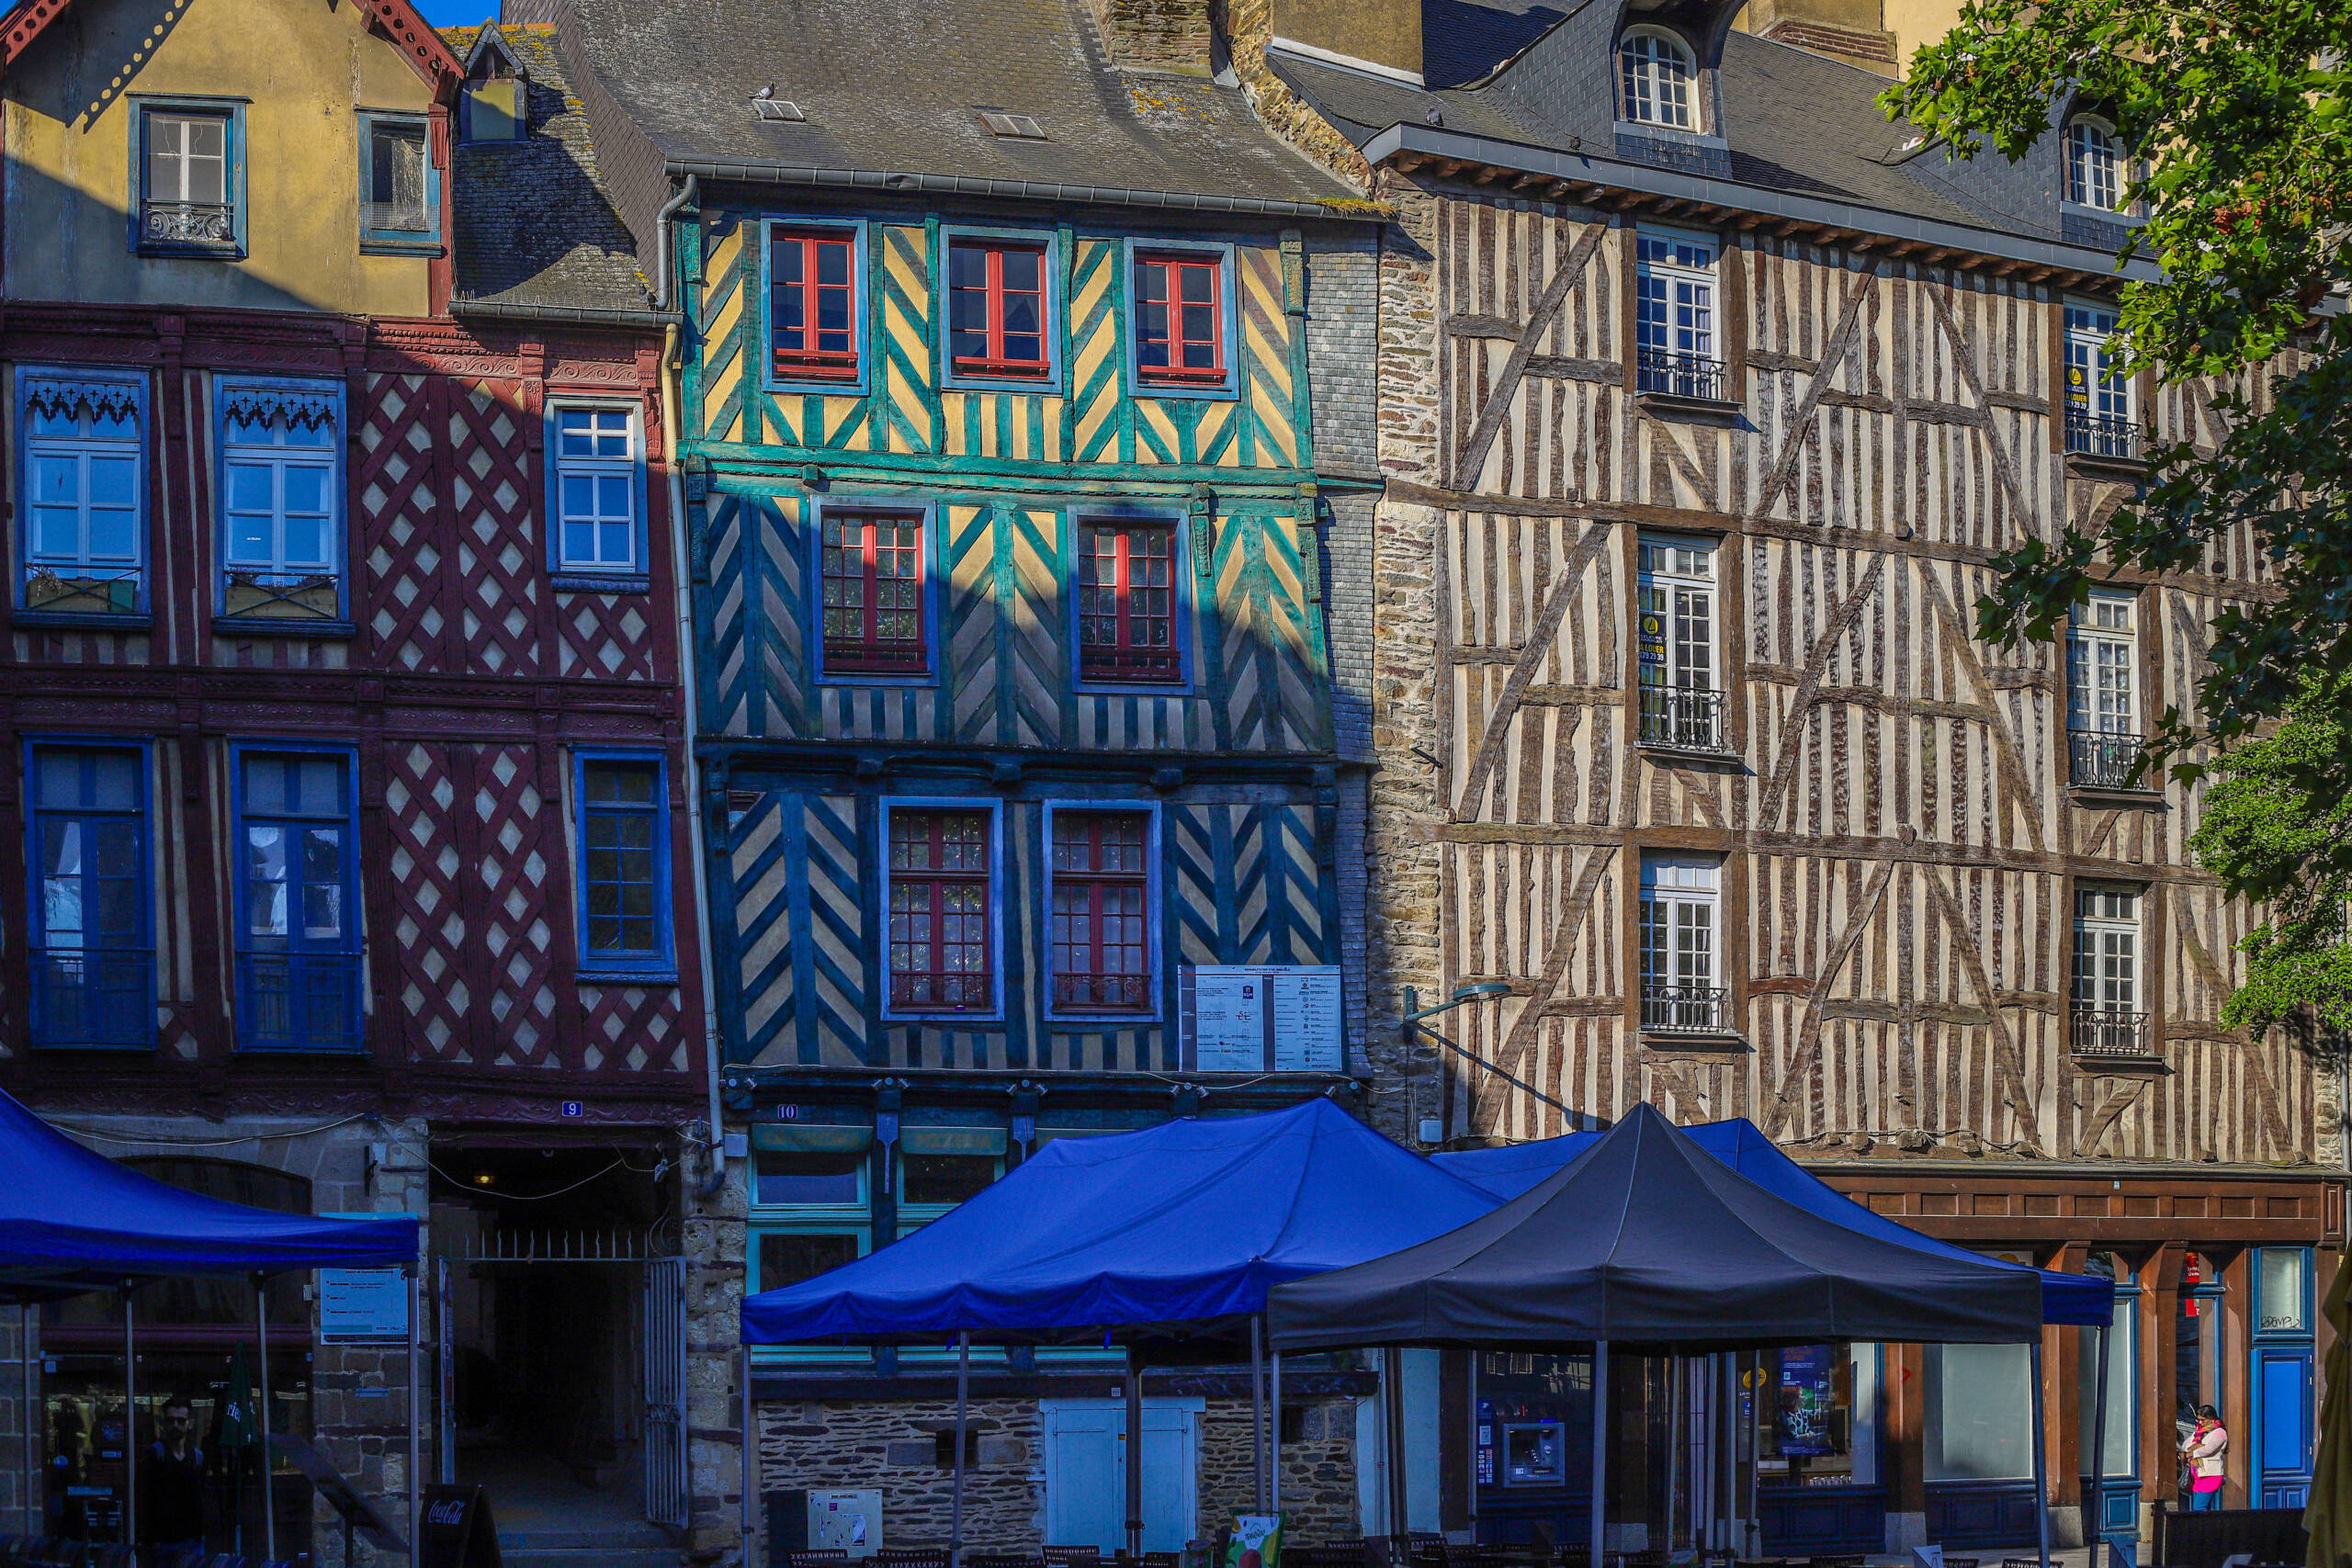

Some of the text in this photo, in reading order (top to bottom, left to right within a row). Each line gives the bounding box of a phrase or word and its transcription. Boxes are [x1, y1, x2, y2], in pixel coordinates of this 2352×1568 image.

[2071, 393, 2087, 402] LOUER
[1645, 644, 1664, 653] LOUER
[570, 1103, 576, 1115] 9
[781, 1105, 795, 1118] 10
[915, 1133, 990, 1148] PIZZERIA
